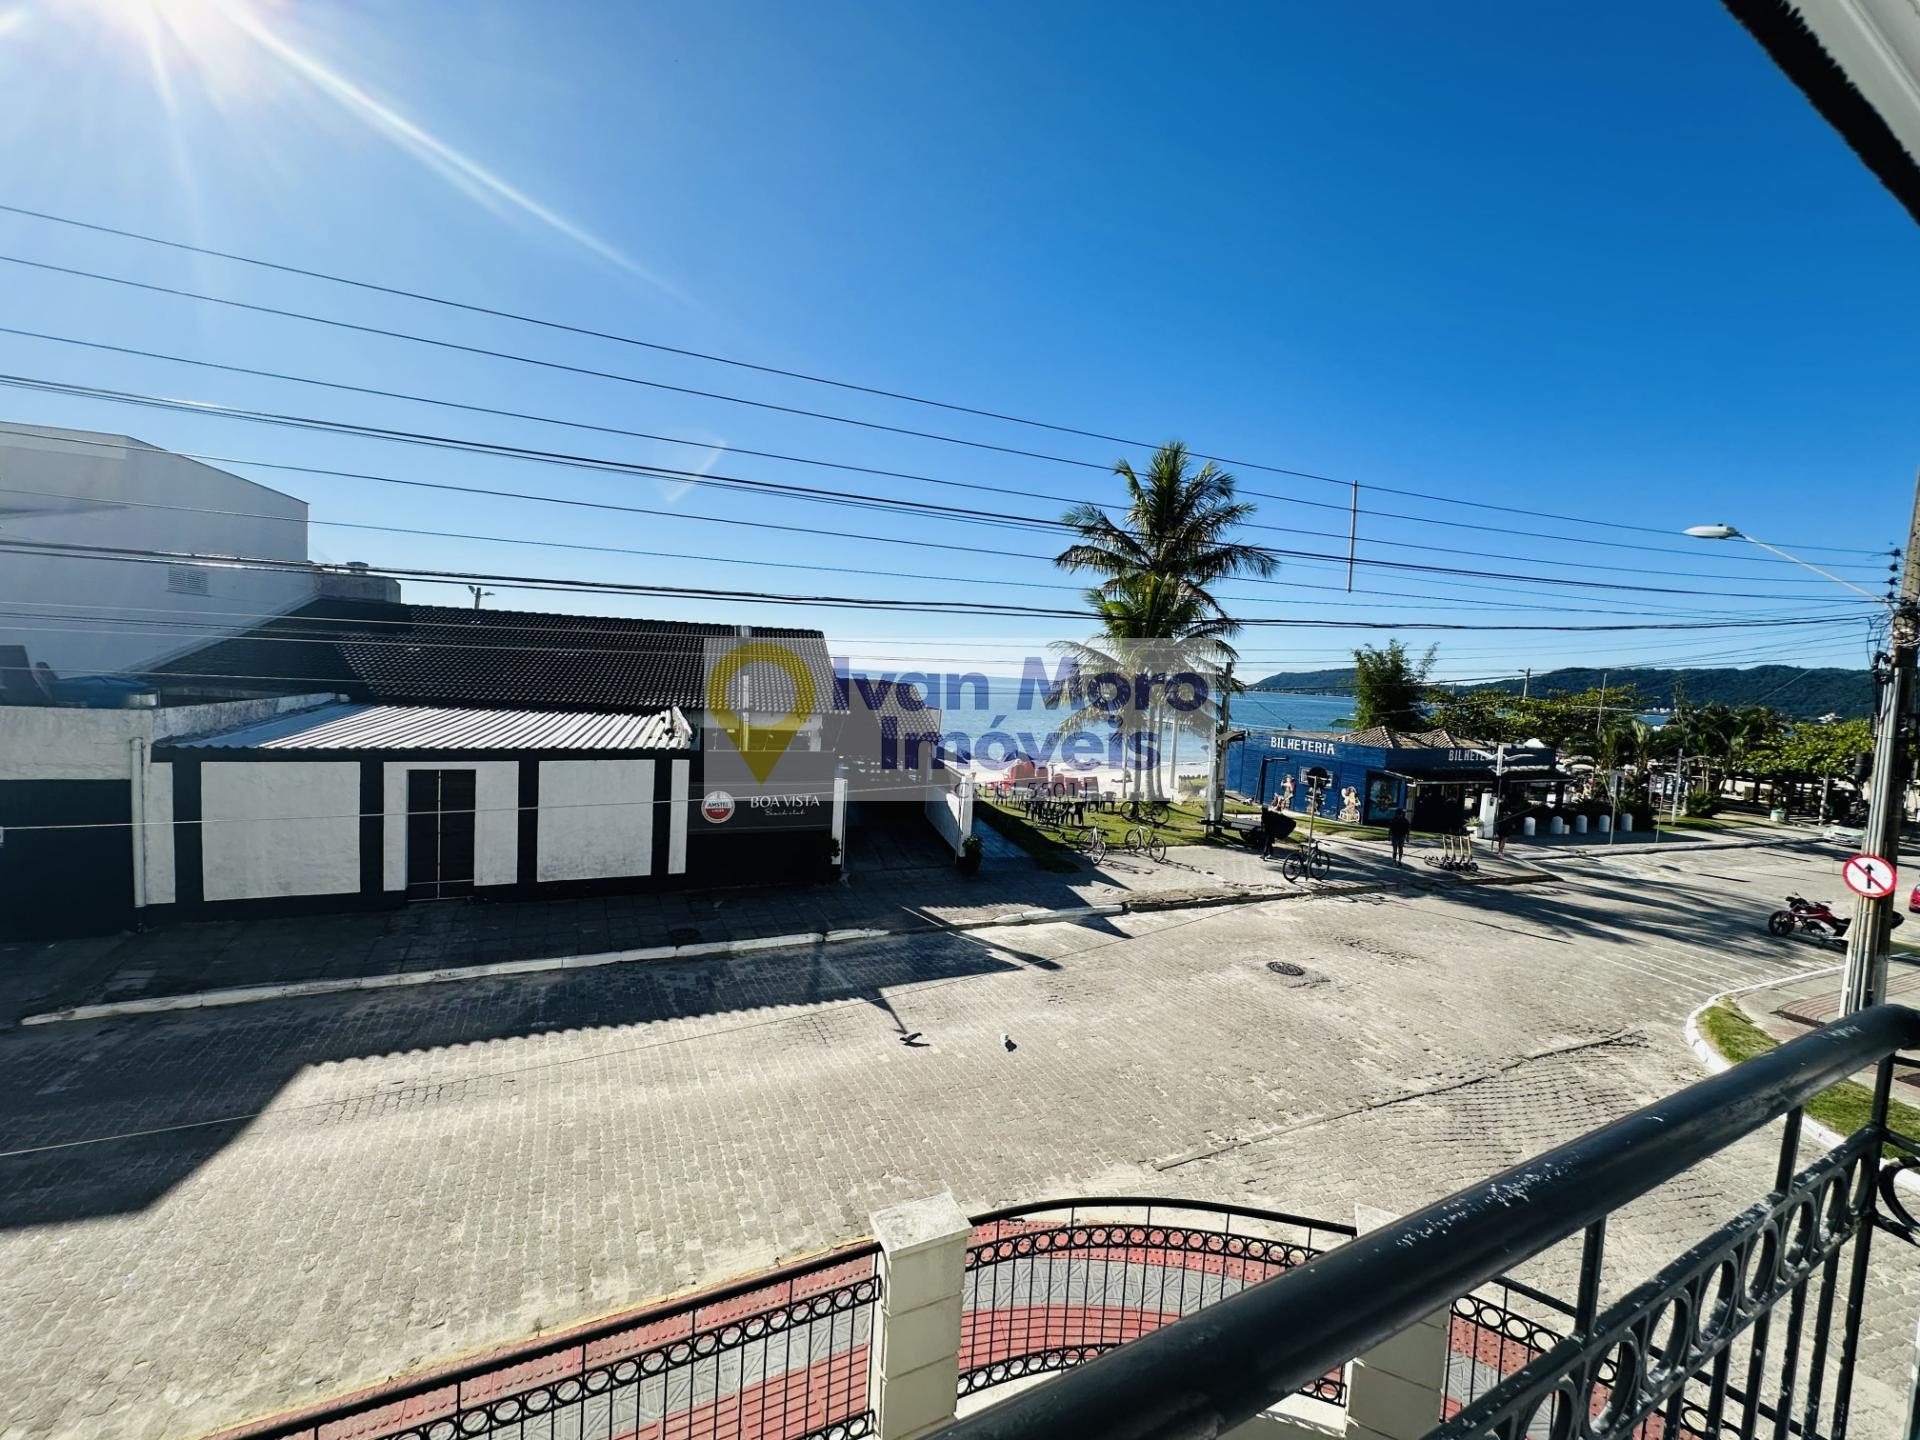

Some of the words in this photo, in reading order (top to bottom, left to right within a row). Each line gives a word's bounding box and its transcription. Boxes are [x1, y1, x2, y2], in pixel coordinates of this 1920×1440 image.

[1270, 736, 1335, 755] BILHETERIA
[1448, 749, 1499, 761] BILHETE
[750, 795, 780, 808] BOA
[782, 795, 820, 807] VISTA
